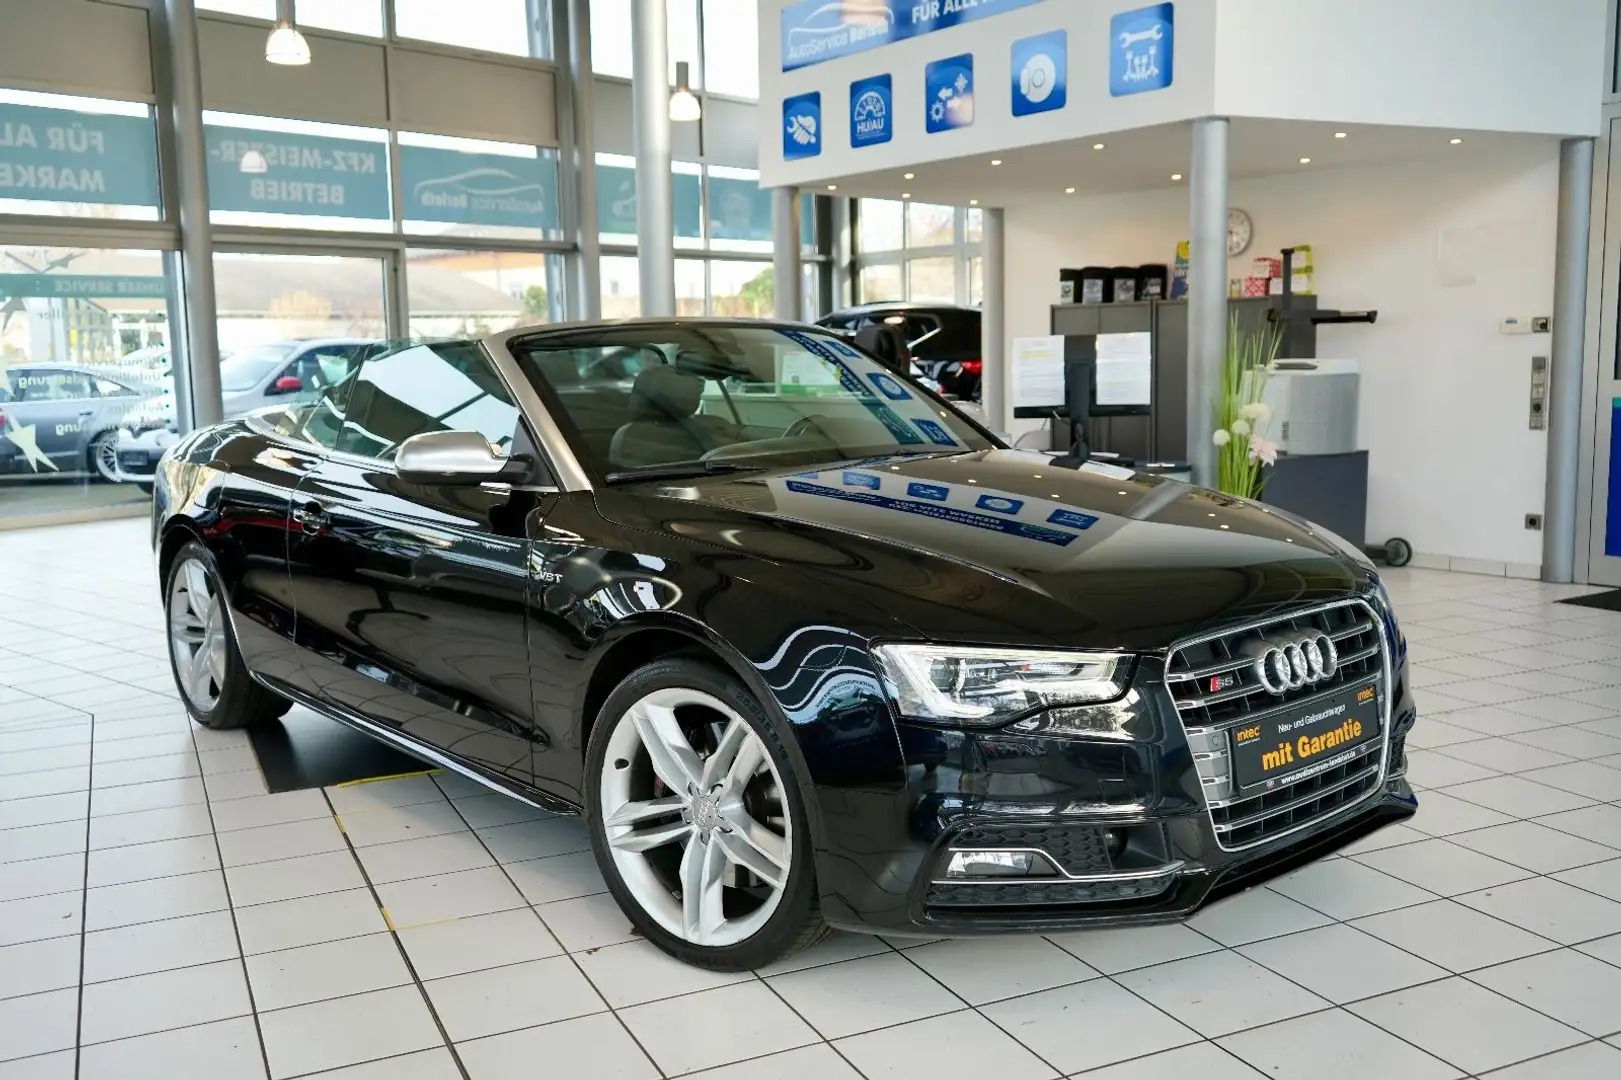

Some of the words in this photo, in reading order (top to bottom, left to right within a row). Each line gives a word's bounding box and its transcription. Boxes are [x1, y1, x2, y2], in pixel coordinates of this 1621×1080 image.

[912, 0, 940, 25] FÜR
[788, 33, 848, 60] AutoService
[1278, 722, 1293, 735] Neu-
[1293, 717, 1305, 730] und
[1304, 704, 1346, 726] Gebrauchtwagen
[1262, 741, 1294, 771] mit
[1297, 718, 1362, 759] Garantie
